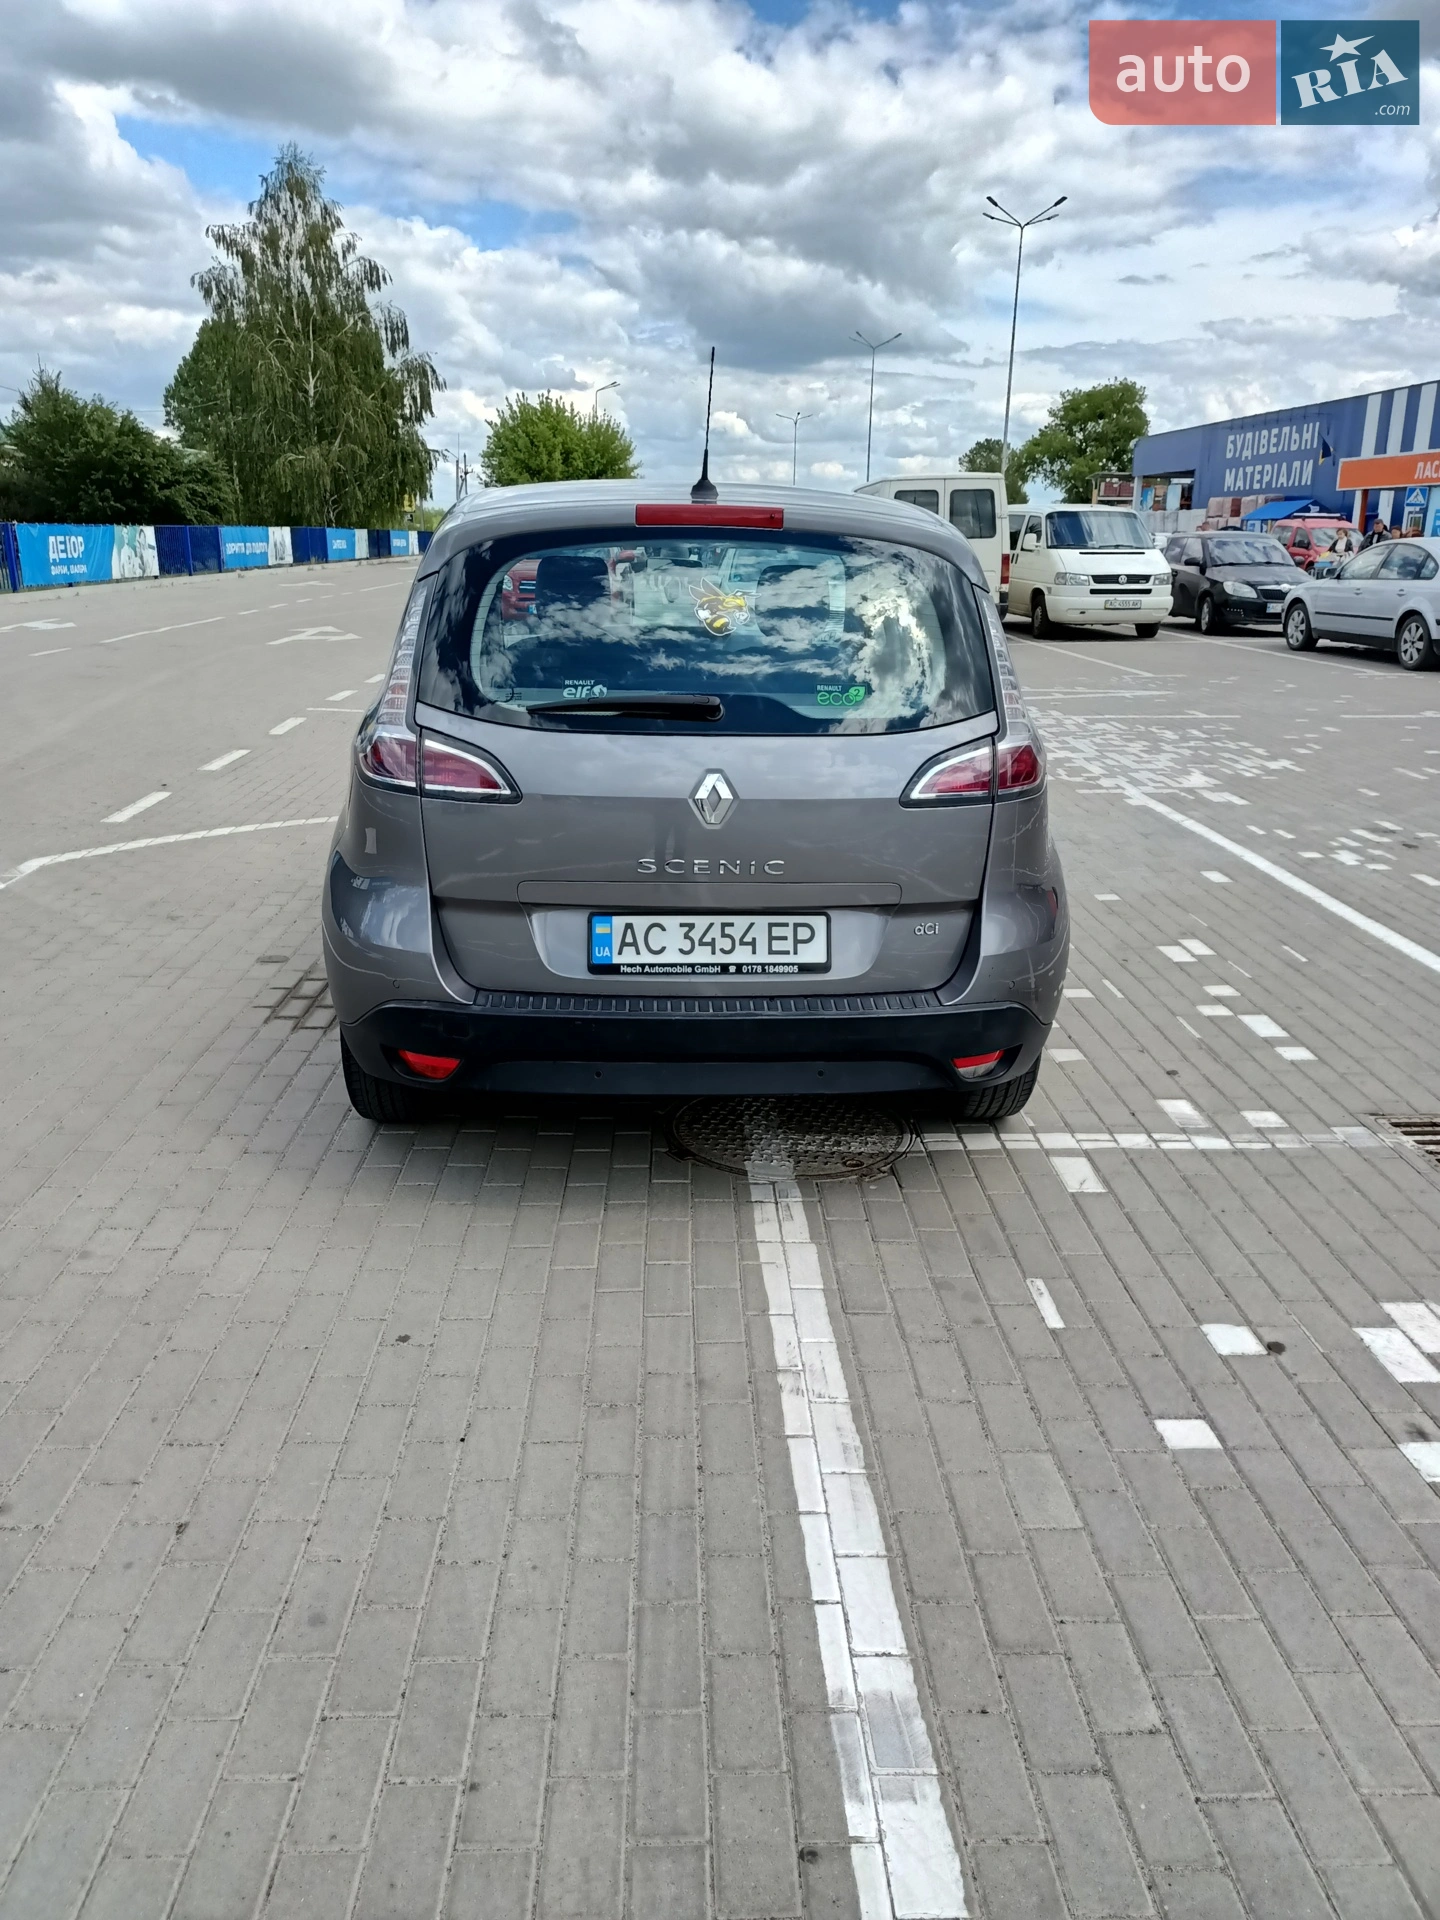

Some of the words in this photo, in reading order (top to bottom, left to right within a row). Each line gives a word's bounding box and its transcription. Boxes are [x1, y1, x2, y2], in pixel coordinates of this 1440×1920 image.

[1225, 421, 1320, 461] БУДІВЕЛЬНІ
[1223, 459, 1314, 492] МАТЕРІАЛИ
[1414, 460, 1440, 480] ЛАС
[562, 686, 591, 698] elf
[637, 858, 785, 875] SCENIC
[914, 922, 939, 935] dCi
[617, 922, 667, 956] AC
[678, 922, 757, 956] 3454
[767, 922, 816, 956] EP
[595, 946, 611, 957] UA
[620, 965, 642, 973] Hech
[643, 965, 692, 973] Automobile
[694, 965, 721, 973] GmbH
[742, 965, 762, 973] 0178
[764, 965, 799, 973] 1849905
